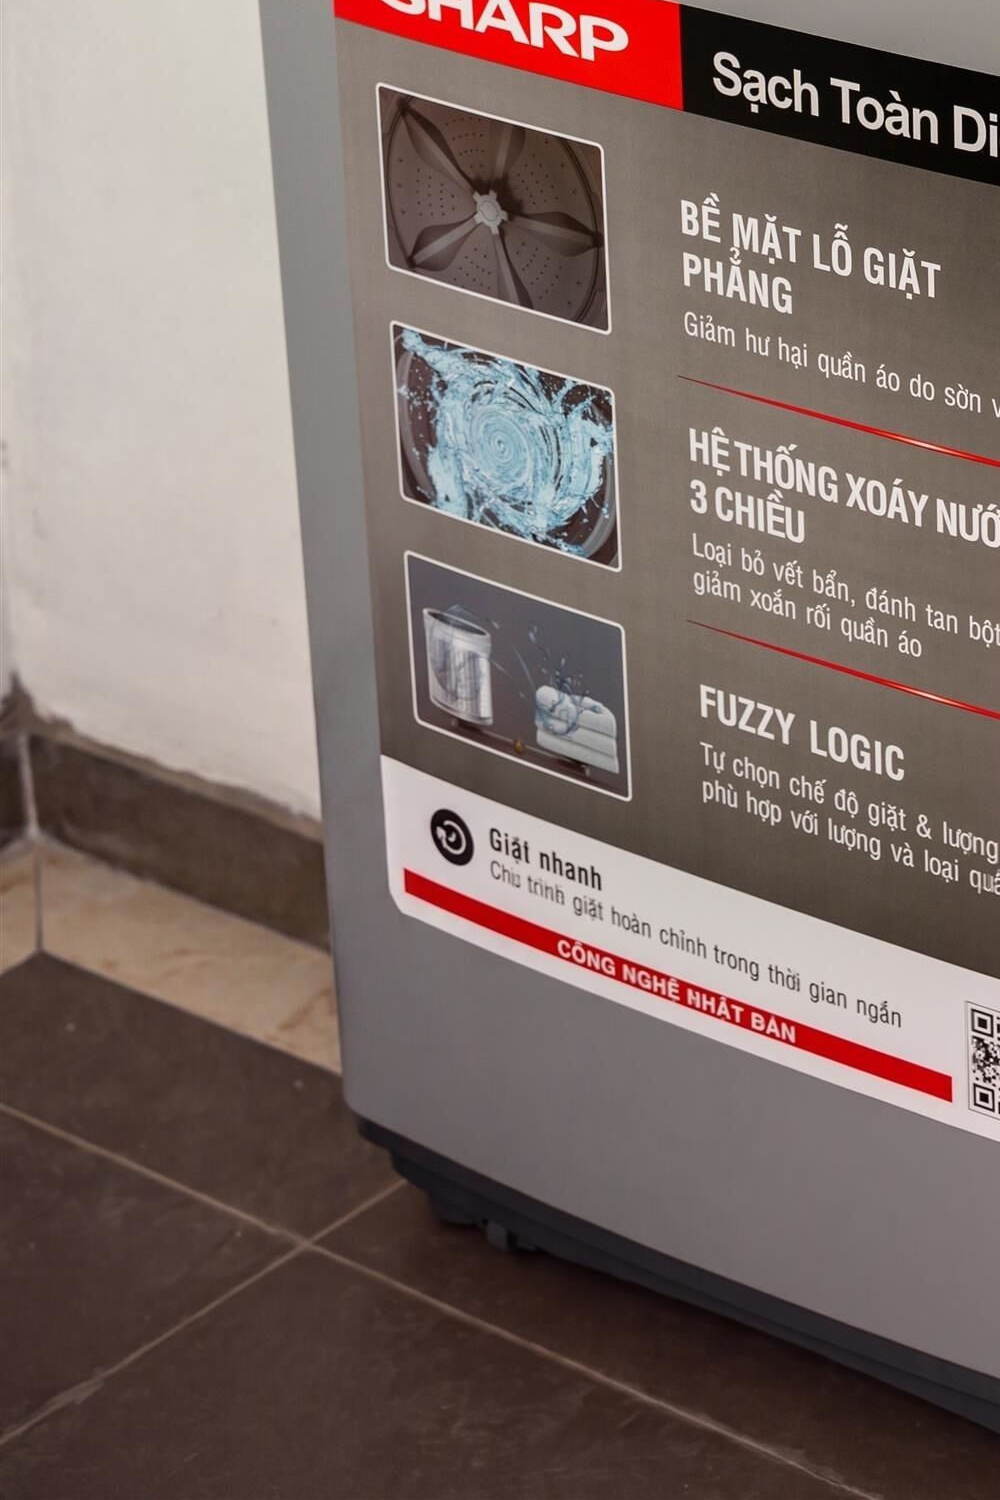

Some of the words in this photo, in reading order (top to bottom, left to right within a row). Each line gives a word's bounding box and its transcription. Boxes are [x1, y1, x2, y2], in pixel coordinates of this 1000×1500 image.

[712, 51, 819, 117] Sạch
[830, 77, 939, 145] Toàn
[681, 192, 720, 243] BỀ
[732, 212, 801, 264] MẶT
[813, 223, 852, 277] LỖ
[863, 248, 941, 300] GIẶT
[682, 246, 793, 315] PHẲNG
[684, 311, 735, 348] Giảm
[745, 327, 771, 356] hư
[778, 337, 808, 369] hại
[818, 351, 865, 384] quần
[876, 364, 900, 392] áo
[909, 374, 935, 401] do
[944, 383, 981, 413] sờn
[689, 426, 729, 476] HỆ
[734, 440, 839, 503] THỐNG
[845, 471, 929, 527] XOÁY
[690, 480, 707, 514] 3
[715, 486, 805, 544] CHIỀU
[692, 533, 732, 567] Loại
[741, 546, 765, 576] bỏ
[773, 559, 804, 588] vết
[812, 569, 856, 608] bẩn,
[865, 587, 916, 622] đánh
[925, 603, 958, 634] tan
[693, 570, 741, 604] giảm
[750, 591, 796, 620] xoắn
[806, 603, 831, 631] rối
[841, 617, 888, 648] quần
[898, 630, 922, 657] áo
[700, 684, 795, 745] FUZZY
[810, 720, 905, 781] LOGIC
[700, 741, 725, 772] Tự
[733, 756, 780, 789] chọn
[789, 771, 827, 804] chế
[834, 787, 859, 818] độ
[868, 801, 906, 832] giặt
[916, 814, 932, 839] &
[942, 821, 998, 864] lượng
[702, 779, 738, 808] phù
[746, 791, 782, 826] hợp
[790, 810, 819, 836] với
[828, 818, 880, 861] lượng
[890, 843, 914, 867] và
[924, 849, 959, 882] loại
[489, 828, 530, 864] Giặt
[539, 849, 602, 891] nhanh
[557, 938, 616, 976] CÔNG
[623, 963, 681, 1002] NGHỆ
[687, 986, 746, 1024] NHẬT
[751, 1010, 796, 1043] BẢN
[572, 894, 604, 921] giặt
[611, 905, 652, 938] hoàn
[659, 925, 707, 959] chỉnh
[714, 944, 759, 981] trong
[768, 963, 801, 993] thời
[809, 980, 847, 1010] gian
[856, 997, 902, 1029] ngắn
